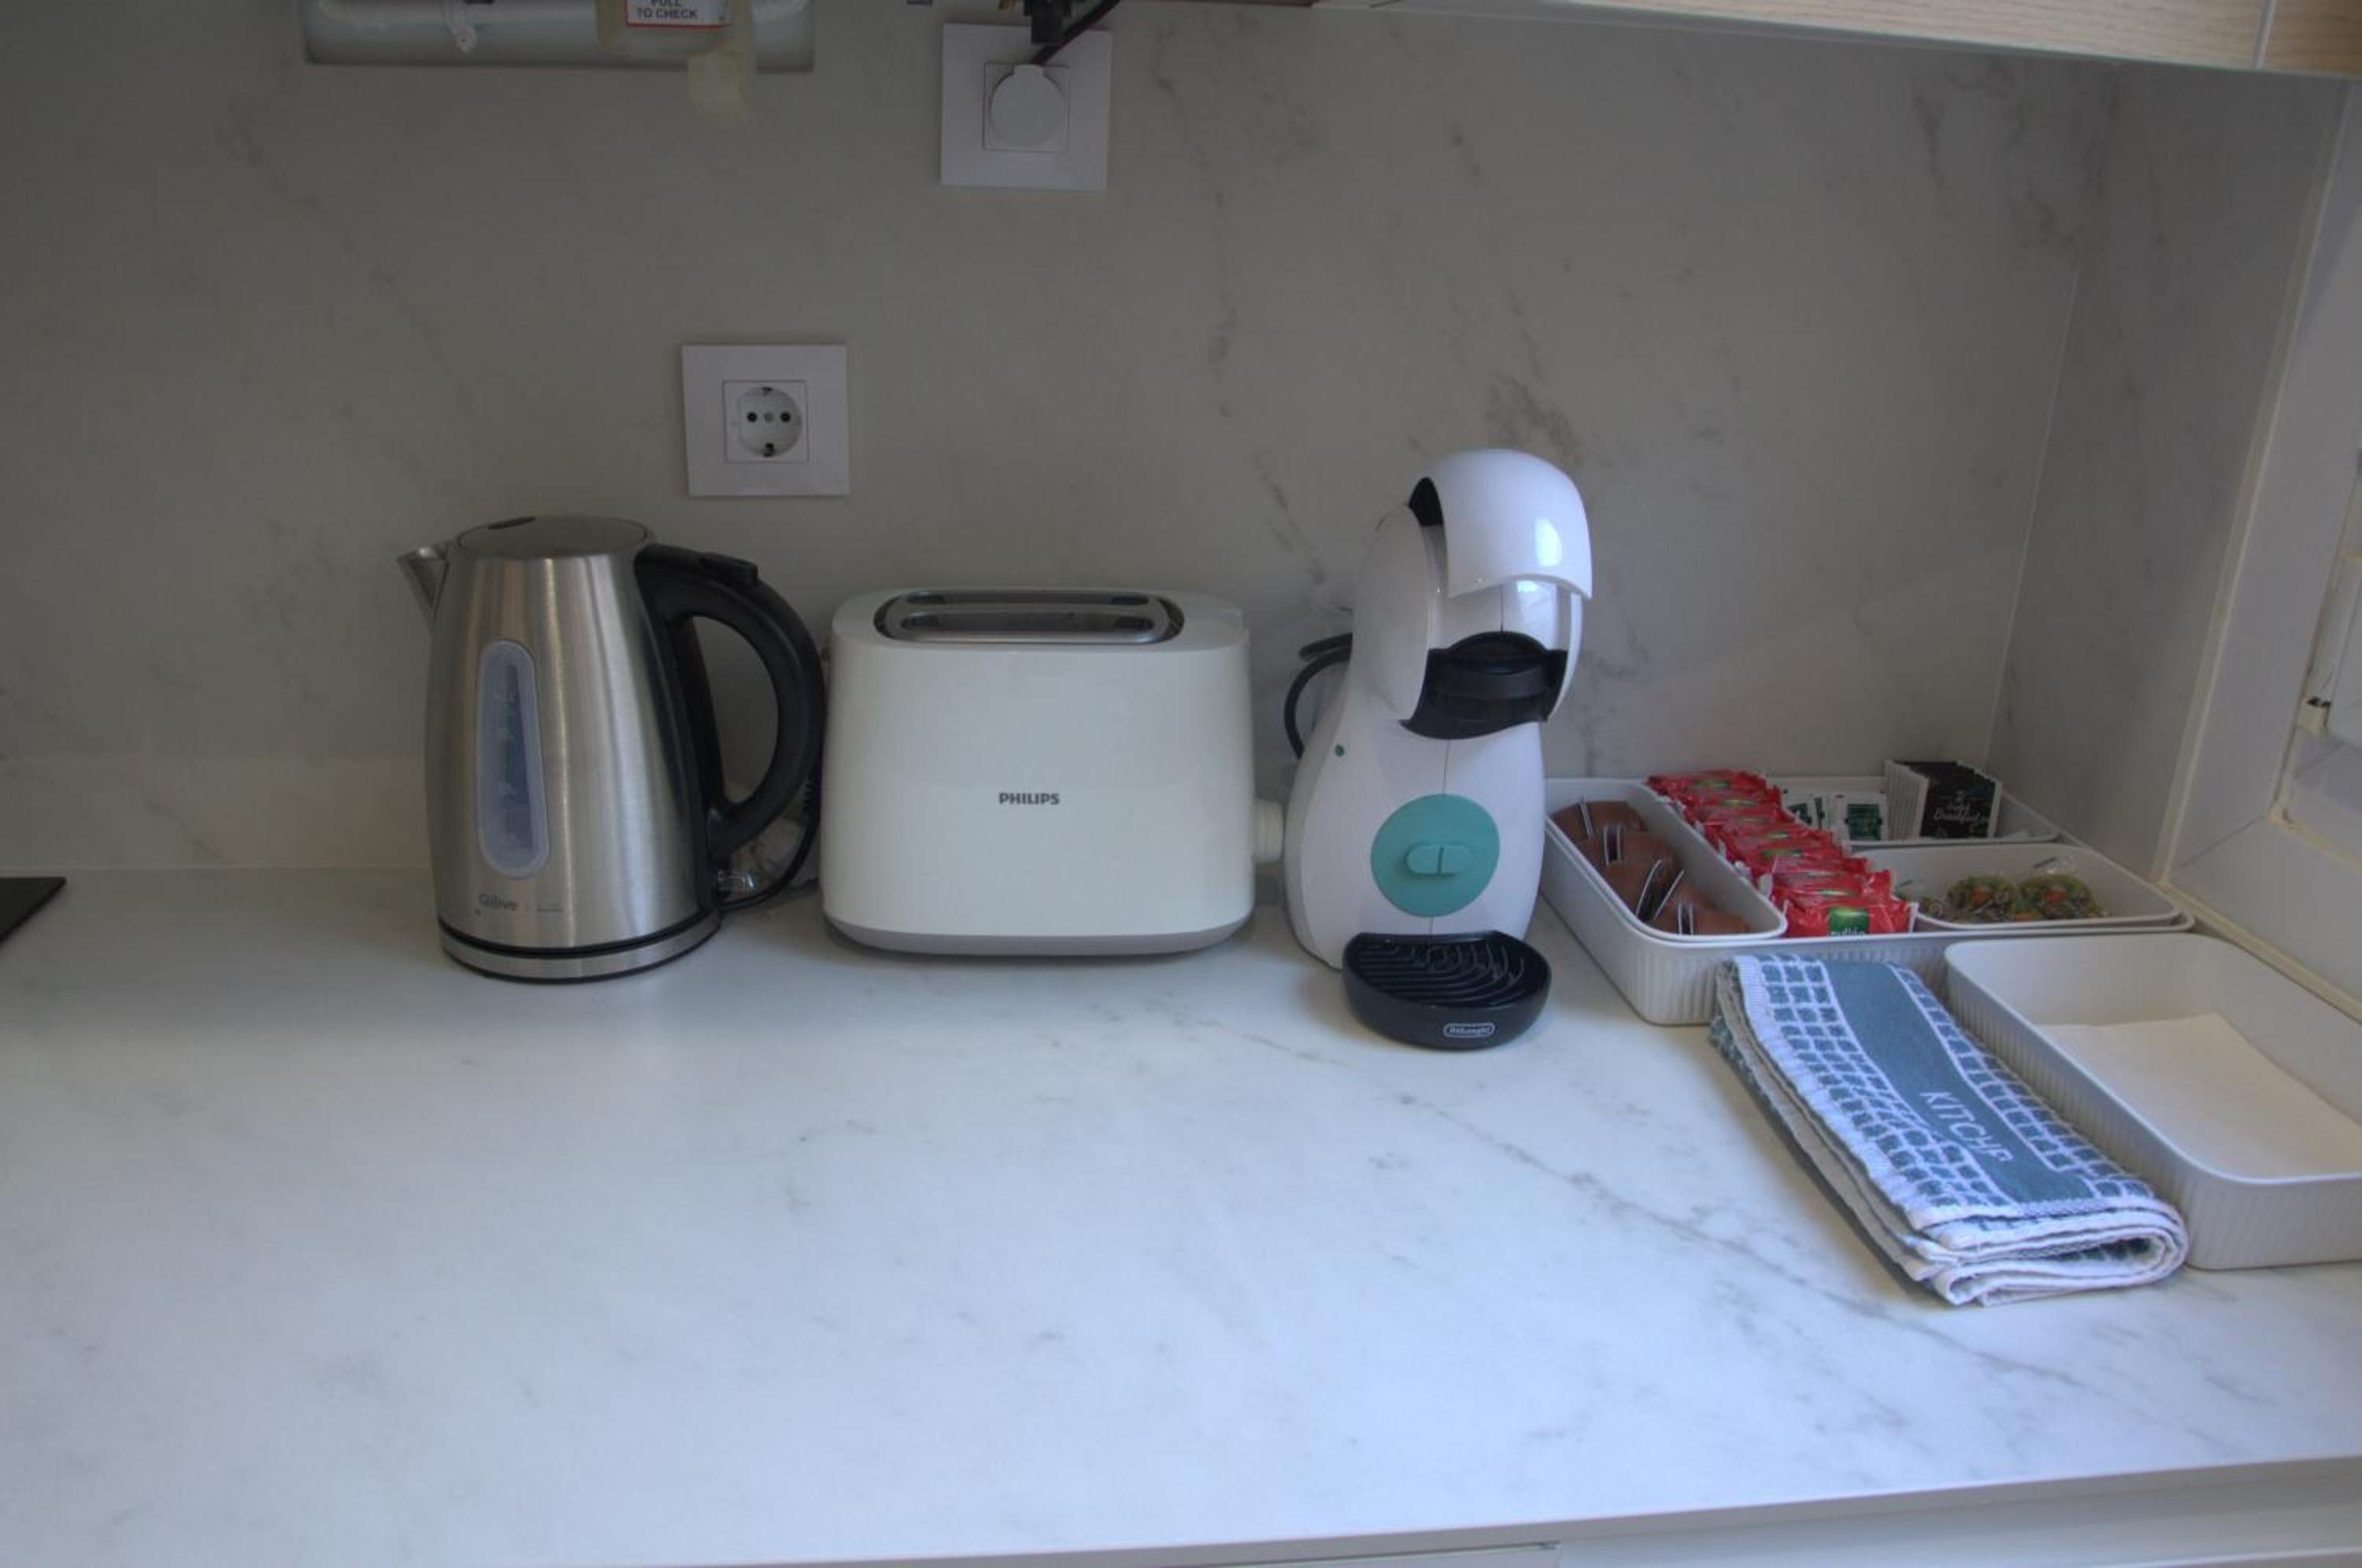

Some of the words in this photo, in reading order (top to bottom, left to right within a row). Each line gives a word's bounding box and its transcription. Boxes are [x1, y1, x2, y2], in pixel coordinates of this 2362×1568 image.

[638, 8, 653, 18] TO
[656, 9, 698, 19] CHECK
[999, 792, 1060, 804] PHILIPS
